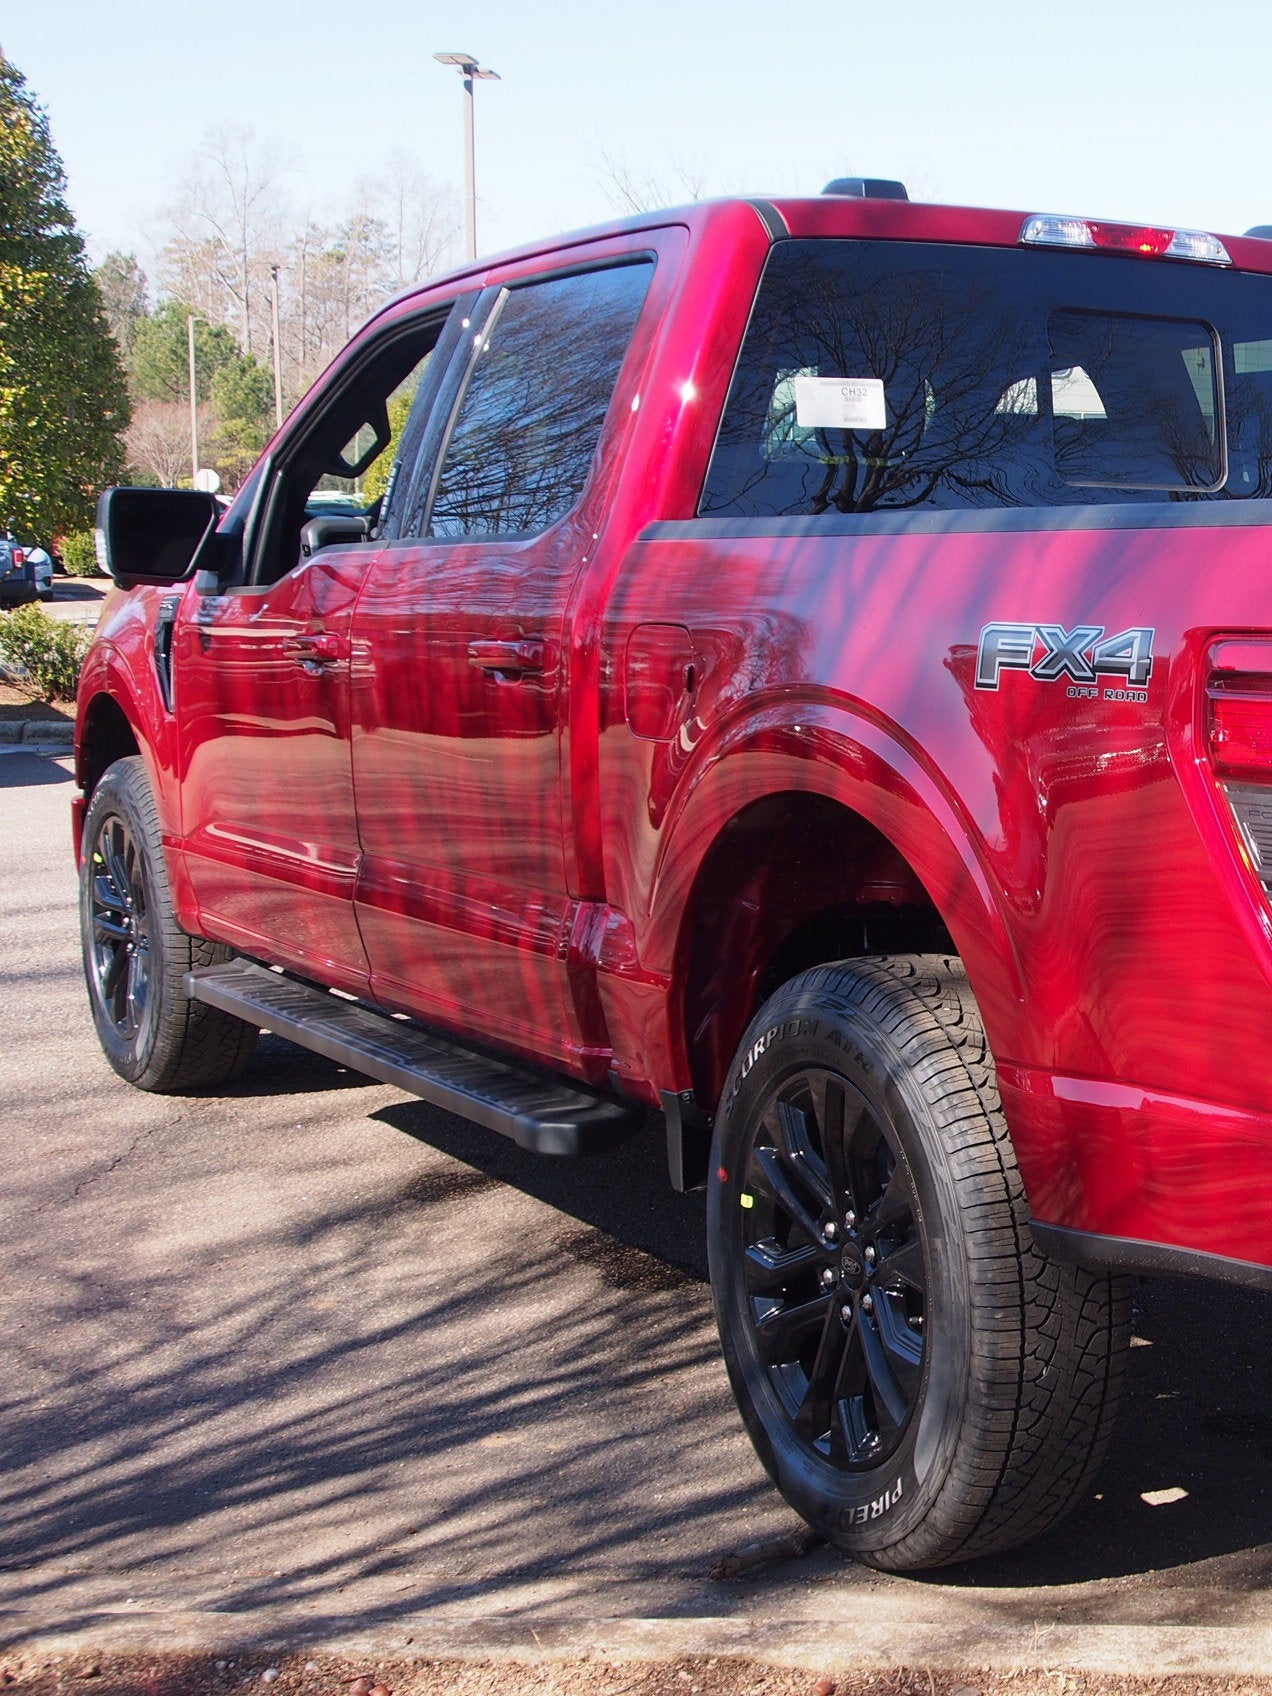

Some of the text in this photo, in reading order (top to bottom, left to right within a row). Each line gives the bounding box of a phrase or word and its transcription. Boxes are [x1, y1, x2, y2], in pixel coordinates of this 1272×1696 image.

[841, 387, 868, 397] CH32
[974, 621, 1155, 691] FX4
[1066, 687, 1148, 703] OFF ROAD
[724, 1019, 819, 1121] SCORPION
[842, 1476, 903, 1525] PIREL
